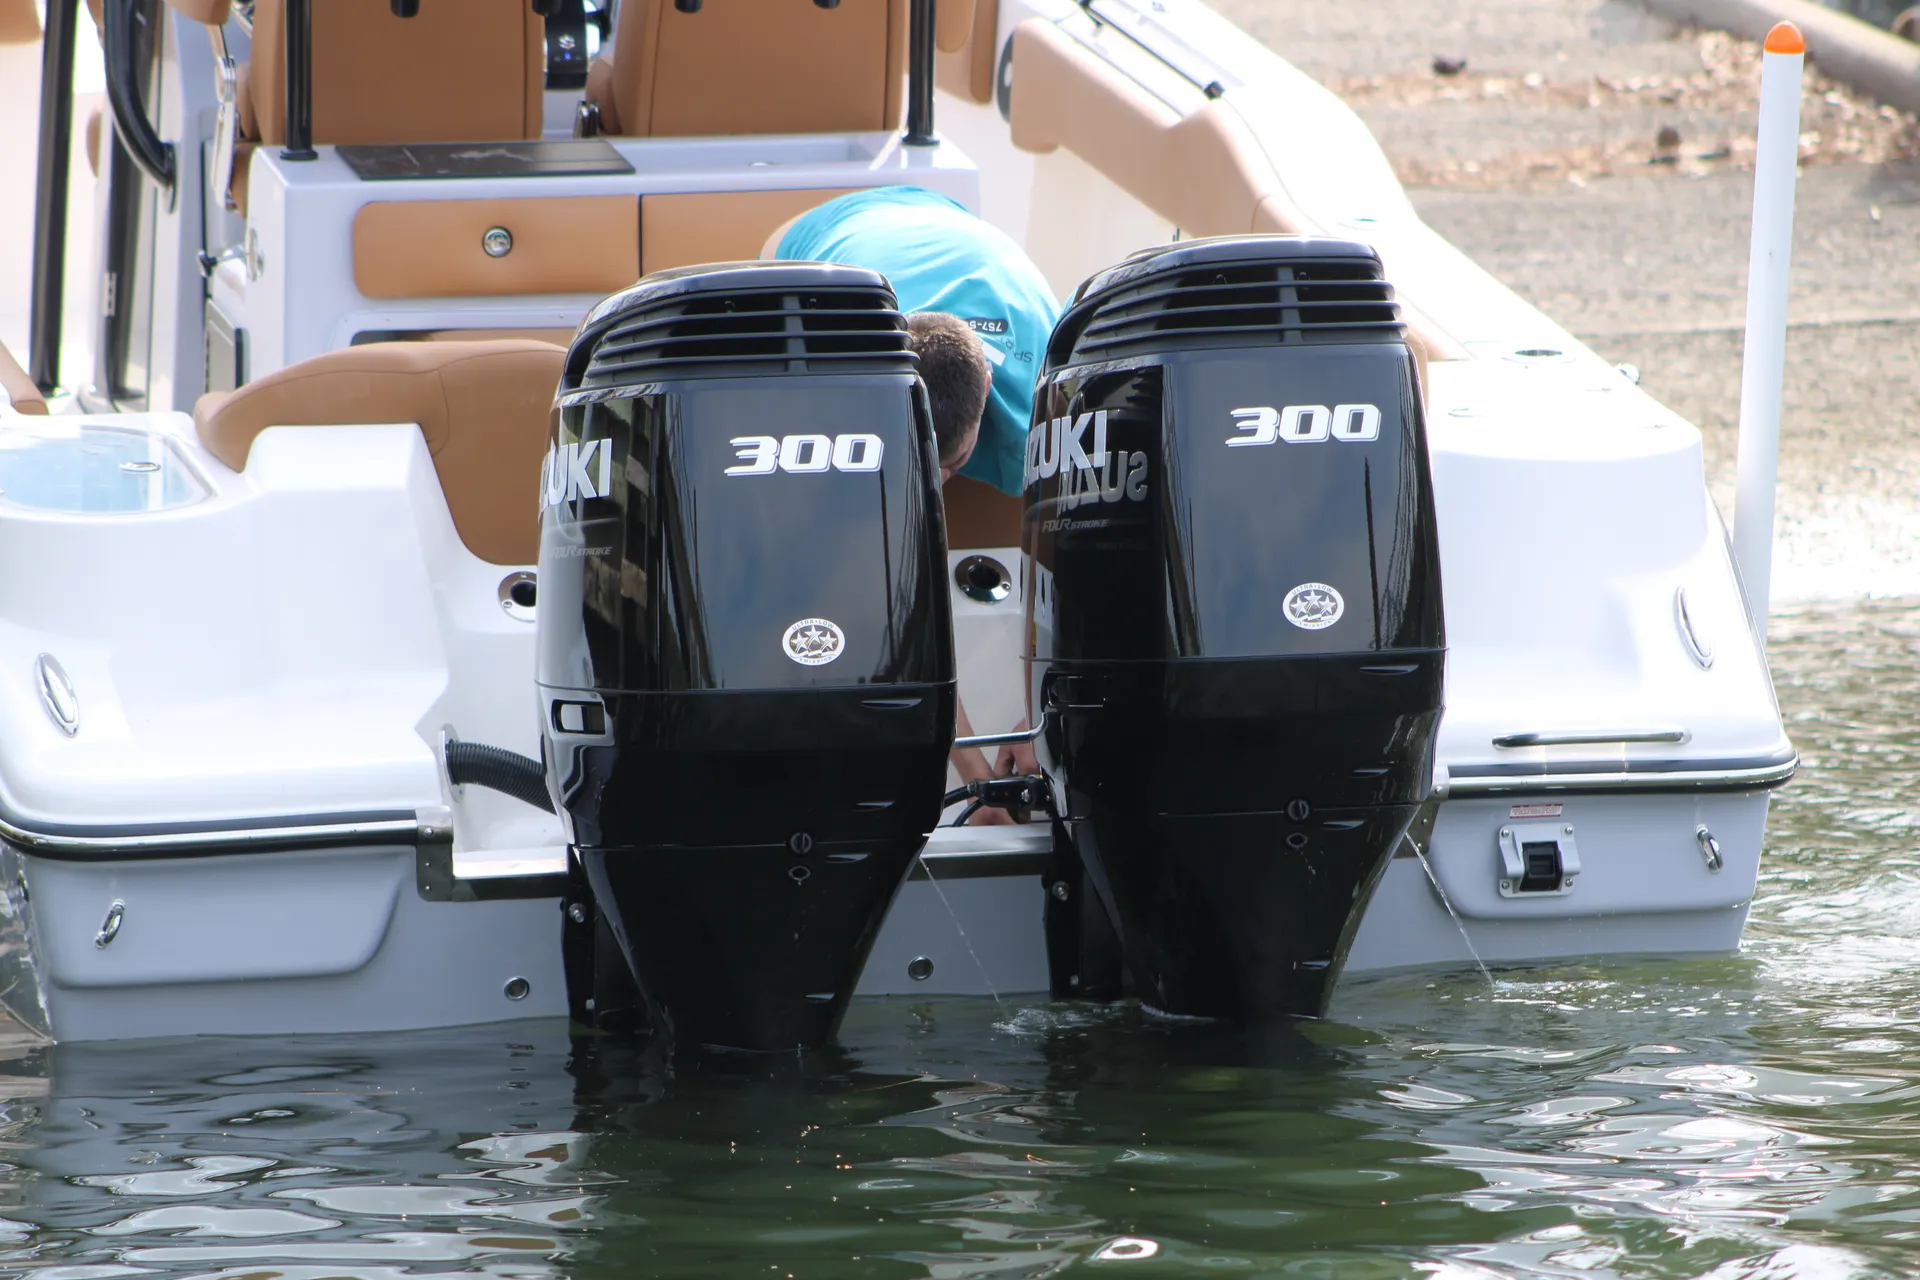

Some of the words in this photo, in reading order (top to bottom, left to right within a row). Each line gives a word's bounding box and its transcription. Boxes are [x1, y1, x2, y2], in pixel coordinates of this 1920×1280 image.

[1225, 404, 1382, 447] 300
[724, 434, 884, 476] 300
[792, 619, 814, 631] ULTRA
[818, 619, 835, 629] LOW
